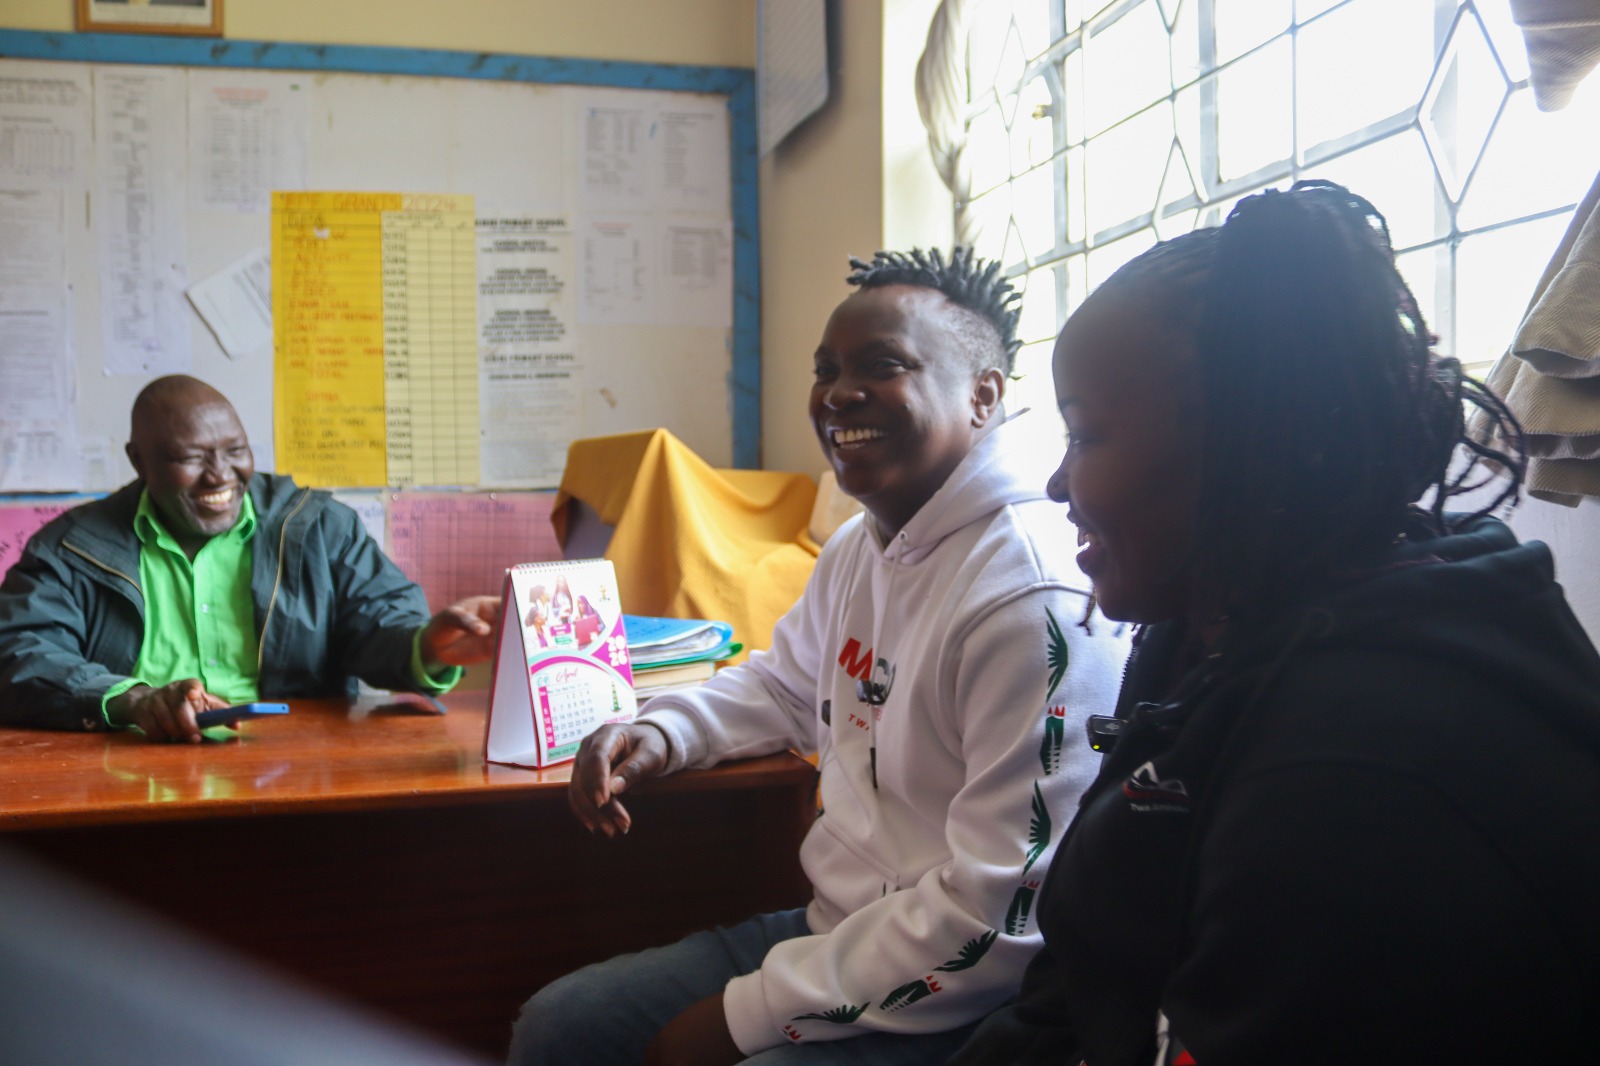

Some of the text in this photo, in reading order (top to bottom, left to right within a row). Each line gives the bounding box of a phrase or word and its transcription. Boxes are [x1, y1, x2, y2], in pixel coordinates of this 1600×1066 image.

[333, 192, 401, 212] GRANTS
[402, 193, 456, 212] 2024
[606, 634, 626, 652] 20
[608, 650, 628, 667] 26
[556, 666, 578, 683] April
